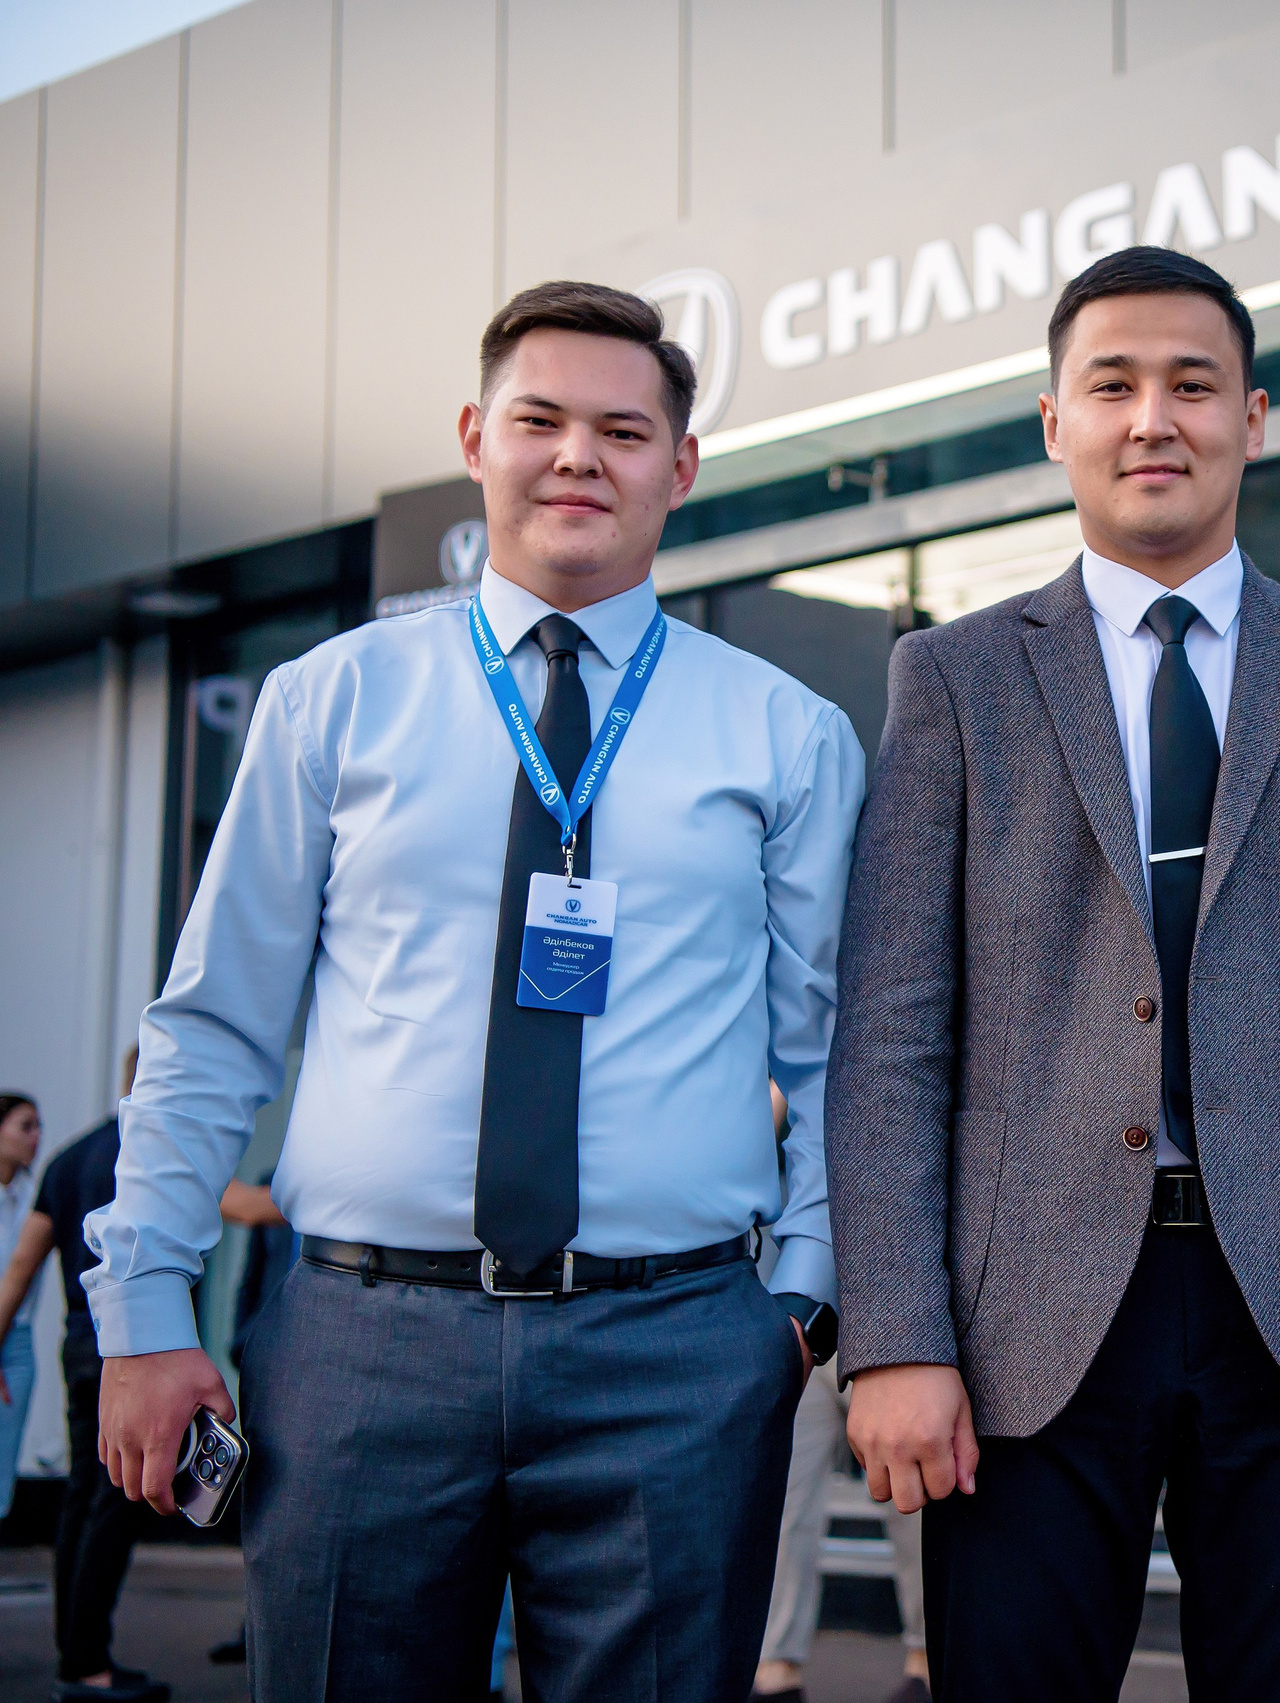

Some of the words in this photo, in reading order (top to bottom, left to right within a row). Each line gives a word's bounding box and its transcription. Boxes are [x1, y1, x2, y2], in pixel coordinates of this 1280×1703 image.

[634, 653, 651, 678] AUTO
[508, 703, 526, 731] AUTO
[519, 728, 548, 784] CHANGAN
[591, 724, 619, 774] CHANGAN
[577, 773, 597, 804] AUTO
[546, 913, 578, 921] CHANGAN
